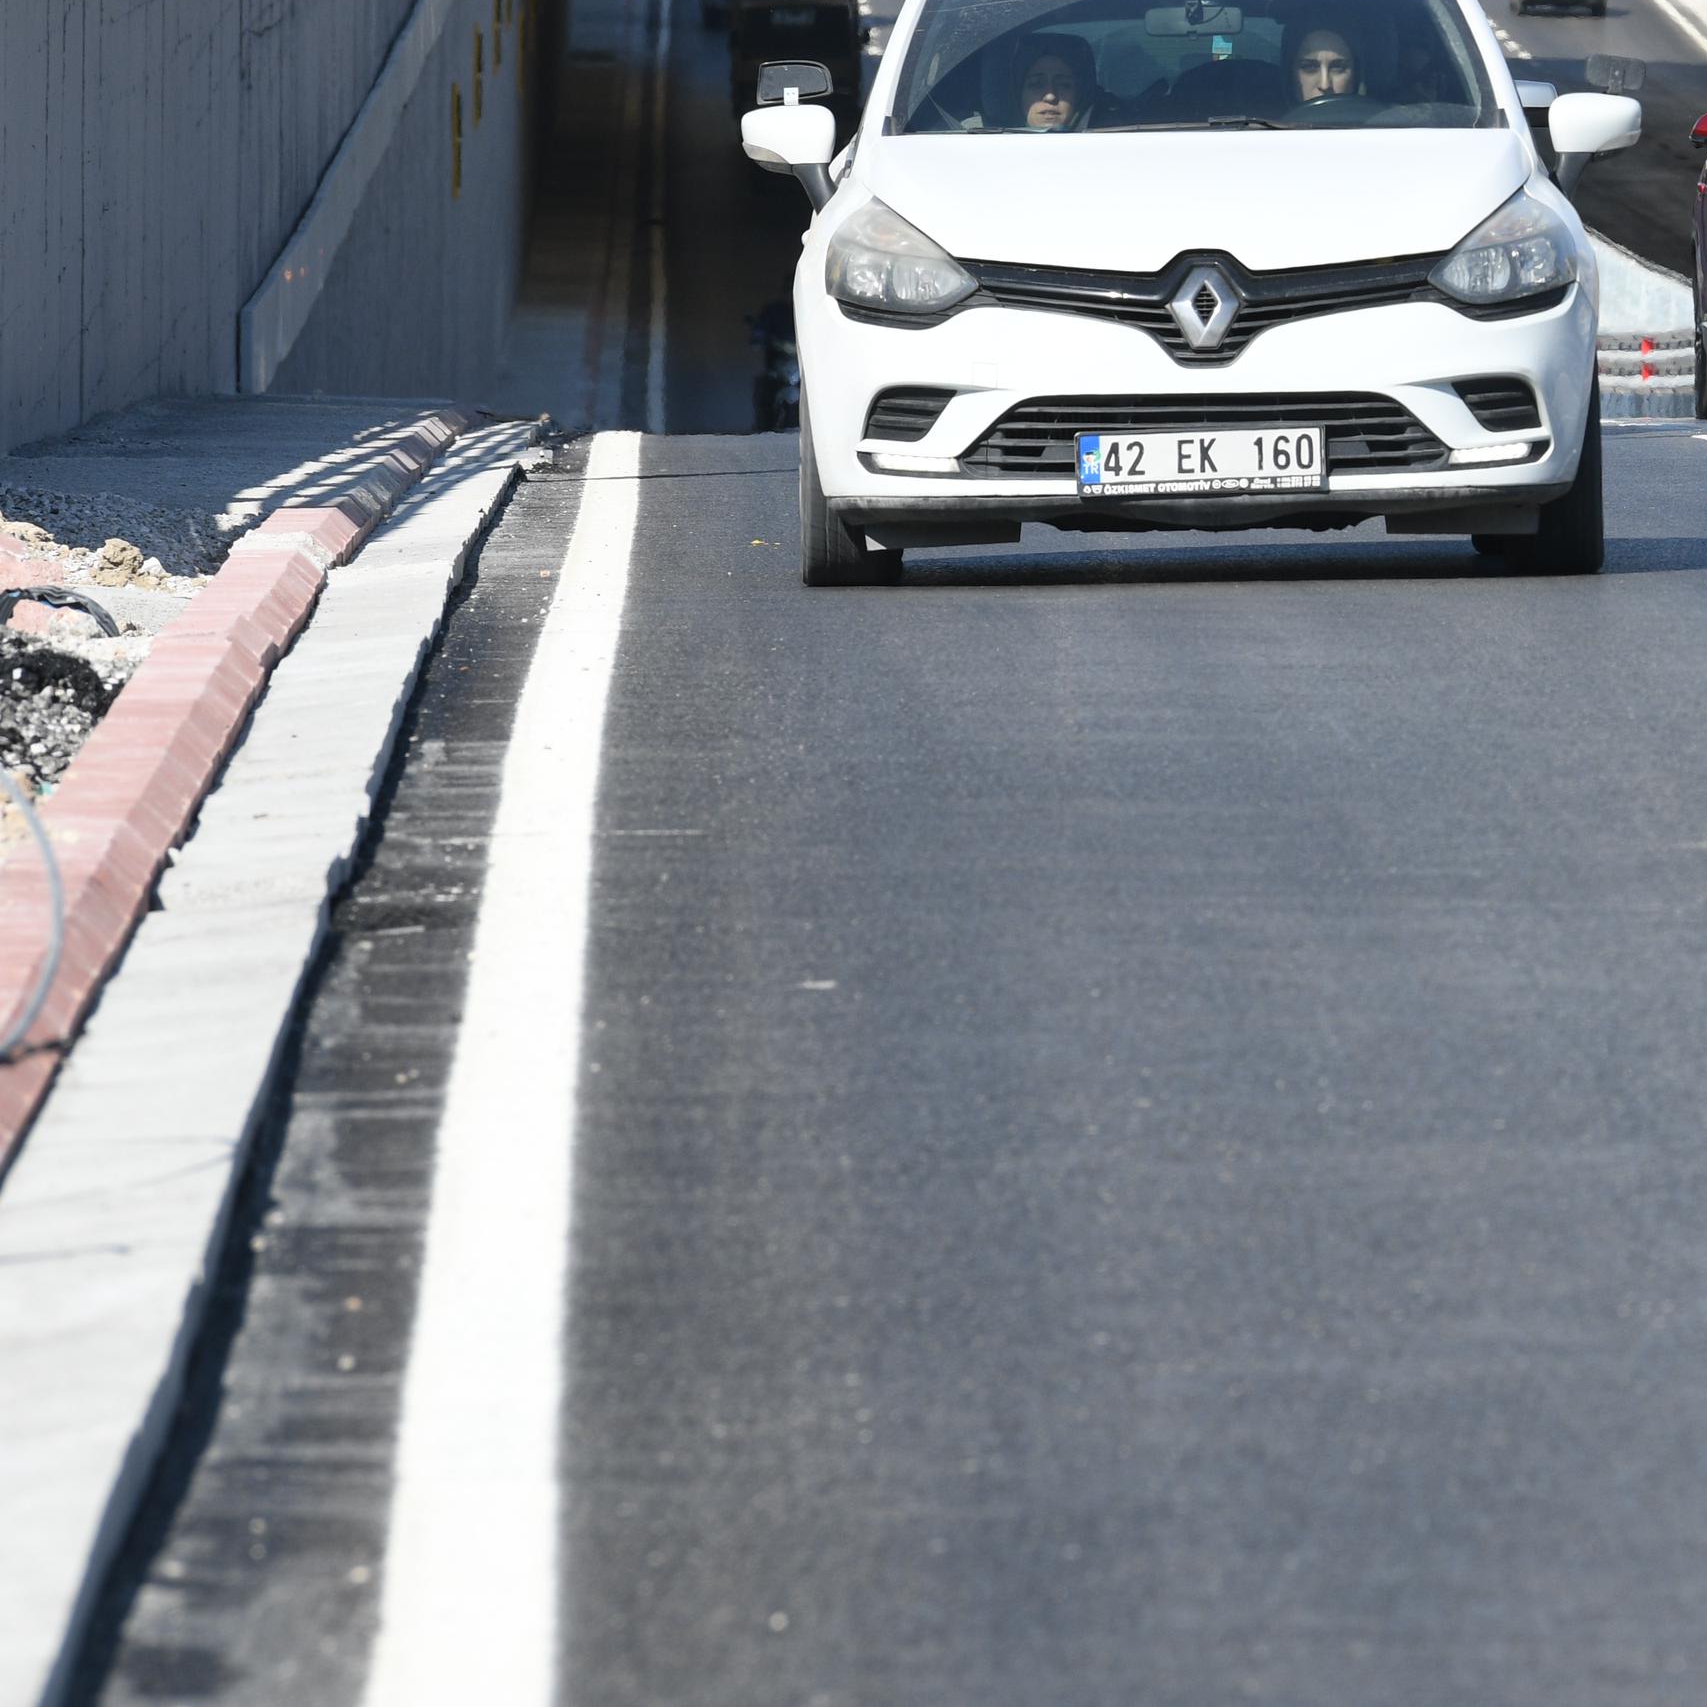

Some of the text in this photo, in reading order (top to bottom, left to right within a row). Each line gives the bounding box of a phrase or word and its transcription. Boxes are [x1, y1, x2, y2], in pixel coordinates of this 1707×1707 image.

[1083, 463, 1099, 475] TR
[1104, 433, 1315, 477] 42 EK 160
